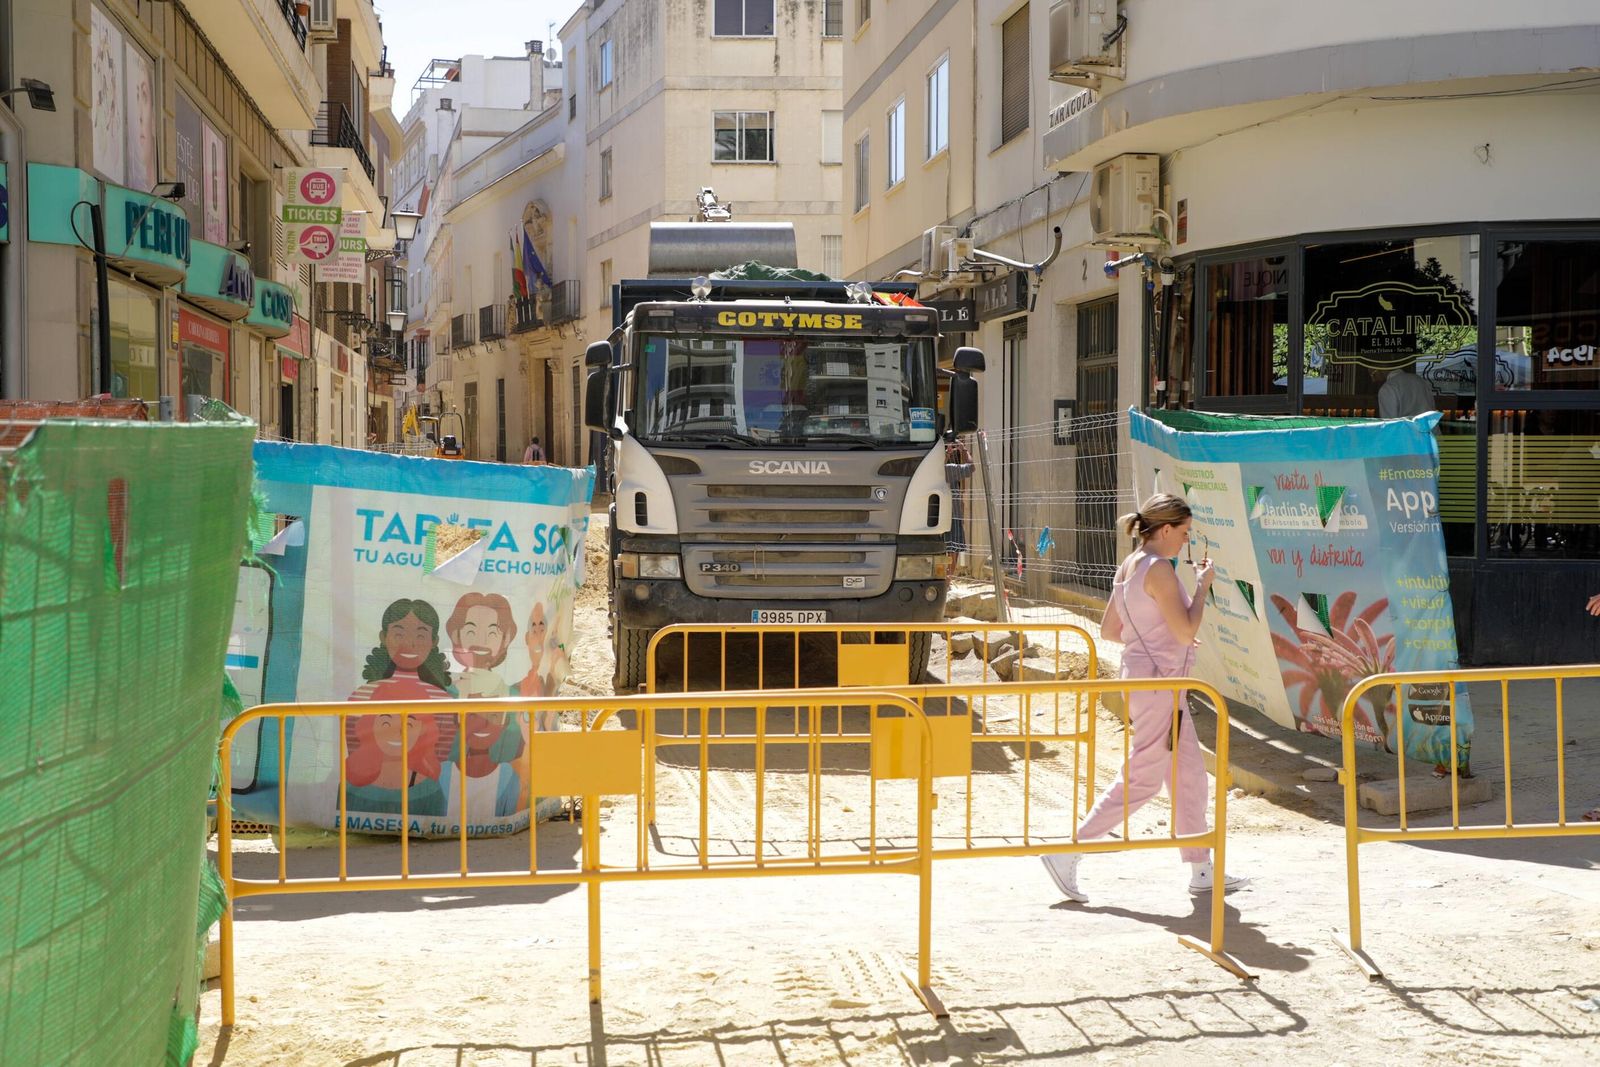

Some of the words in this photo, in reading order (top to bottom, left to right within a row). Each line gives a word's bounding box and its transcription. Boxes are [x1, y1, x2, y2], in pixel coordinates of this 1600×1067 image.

[312, 182, 325, 190] BUS
[287, 208, 338, 222] TICKETS
[125, 201, 191, 267] PERFU
[287, 230, 296, 255] TRAIN
[1082, 258, 1088, 281] 2
[718, 311, 863, 329] COTYMSE
[941, 306, 969, 322] LÉ
[1326, 314, 1450, 338] CATALINA
[1371, 338, 1381, 347] EL
[1384, 337, 1402, 347] BAR
[749, 460, 831, 474] SCANIA
[1274, 467, 1310, 490] visita
[1265, 501, 1298, 517] Jardín
[1387, 487, 1436, 519] App
[356, 508, 519, 552] TARA
[1389, 520, 1430, 534] Versión
[353, 548, 378, 564] TU
[382, 551, 424, 568] AGU
[1267, 548, 1286, 565] ven
[1291, 549, 1303, 578] y
[1310, 544, 1364, 568] disfruta
[702, 563, 710, 572] P
[712, 563, 739, 572] 340
[760, 611, 794, 624] 9985
[798, 611, 823, 624] DPX
[431, 820, 446, 835] tu
